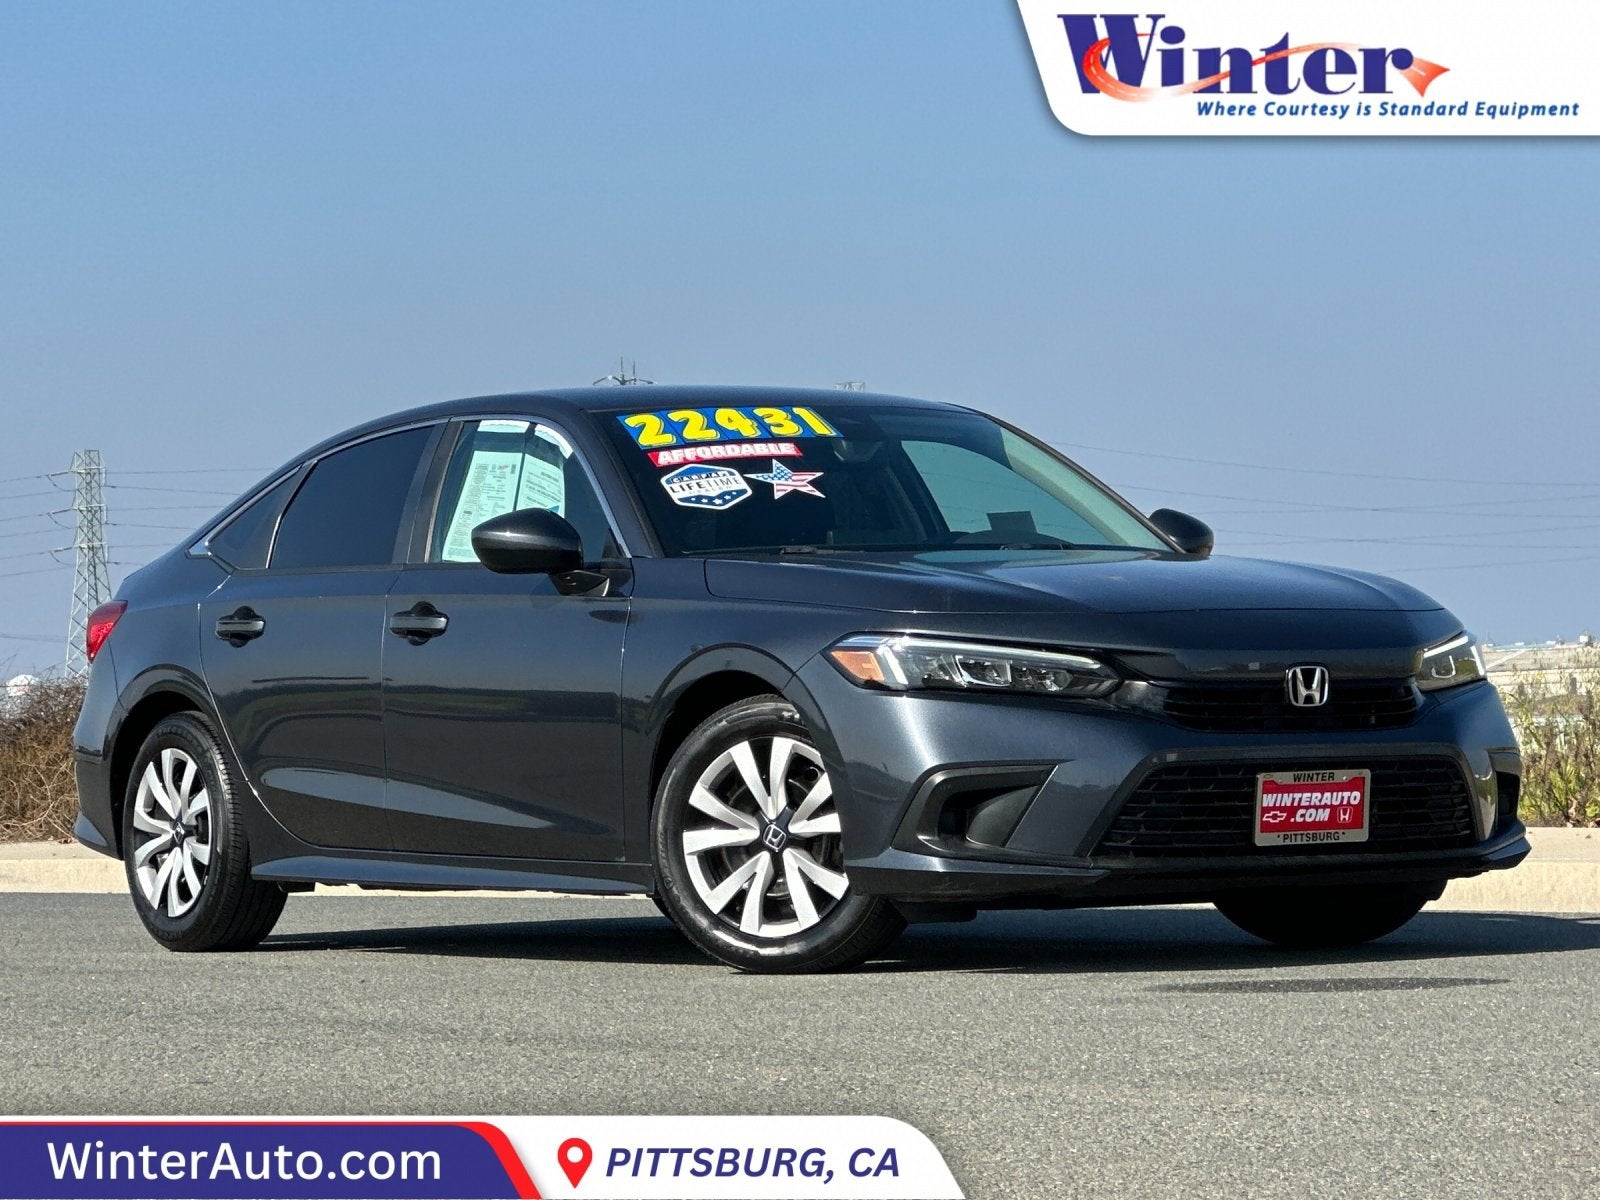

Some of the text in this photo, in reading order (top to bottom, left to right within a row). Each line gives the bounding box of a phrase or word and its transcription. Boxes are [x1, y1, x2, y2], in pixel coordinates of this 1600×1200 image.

[624, 407, 836, 446] 22431
[657, 442, 796, 465] AFFORDABLE
[669, 477, 742, 493] LIFETIME
[1293, 772, 1335, 782] WINTER
[1262, 791, 1361, 807] WINTERAUTO
[1290, 808, 1331, 822] .COM
[1283, 831, 1340, 843] PITTSBURG
